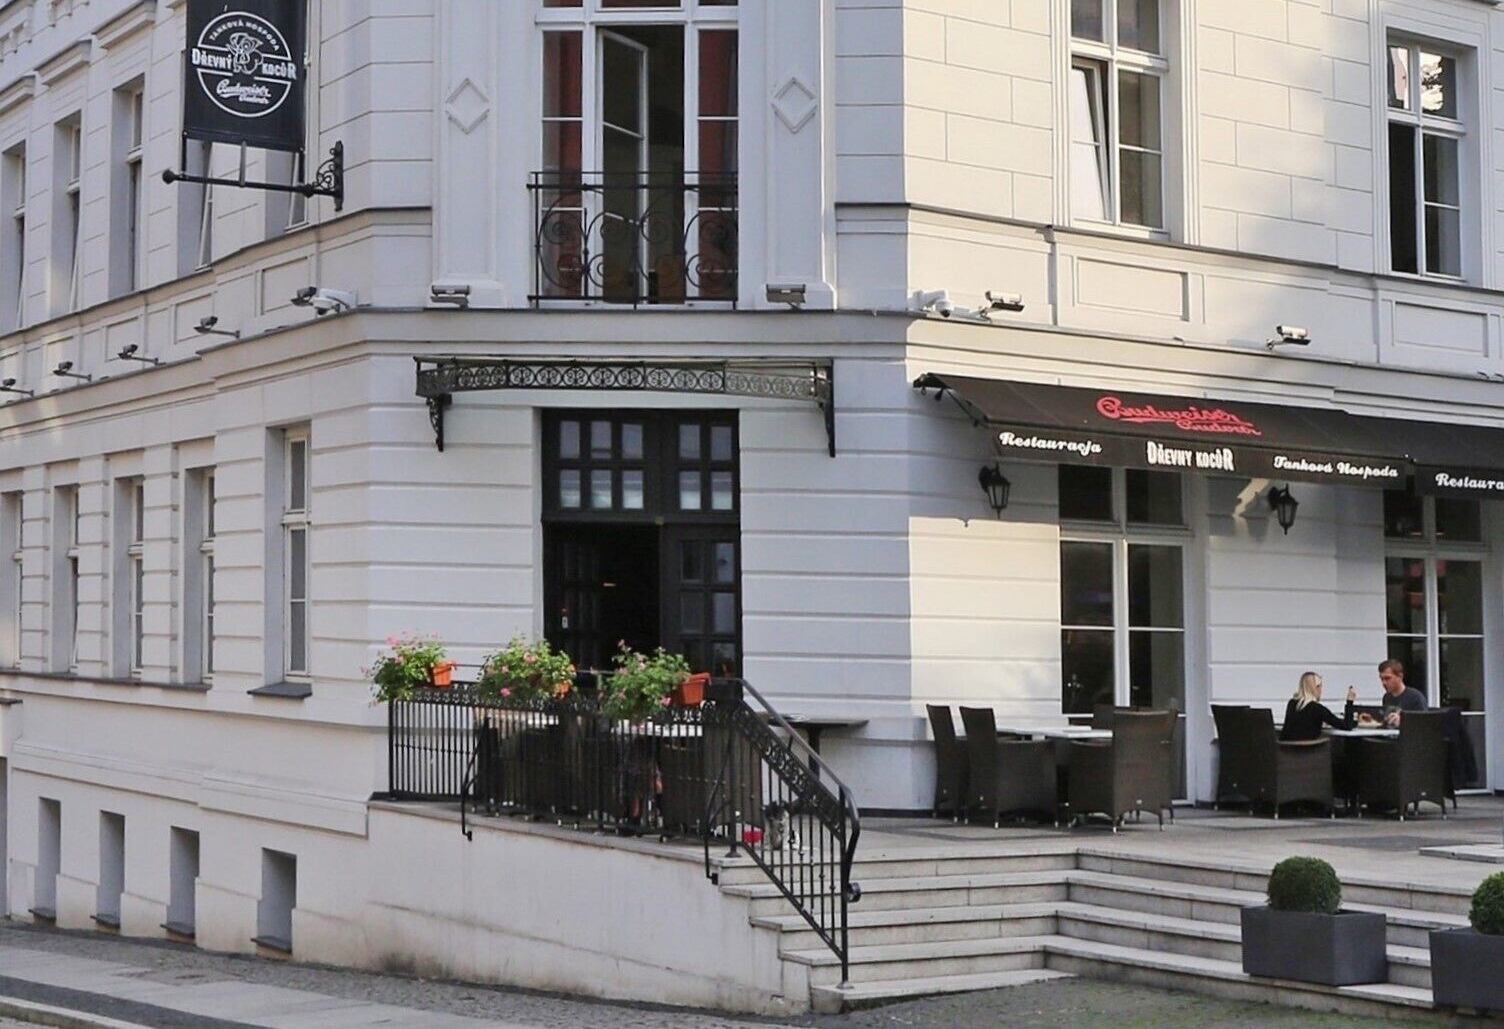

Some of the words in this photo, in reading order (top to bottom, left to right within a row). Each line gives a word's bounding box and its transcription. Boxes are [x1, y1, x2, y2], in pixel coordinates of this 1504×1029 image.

[999, 432, 1102, 456] Restauracja
[1273, 456, 1333, 473] Tanková
[1336, 462, 1399, 479] Hospoda
